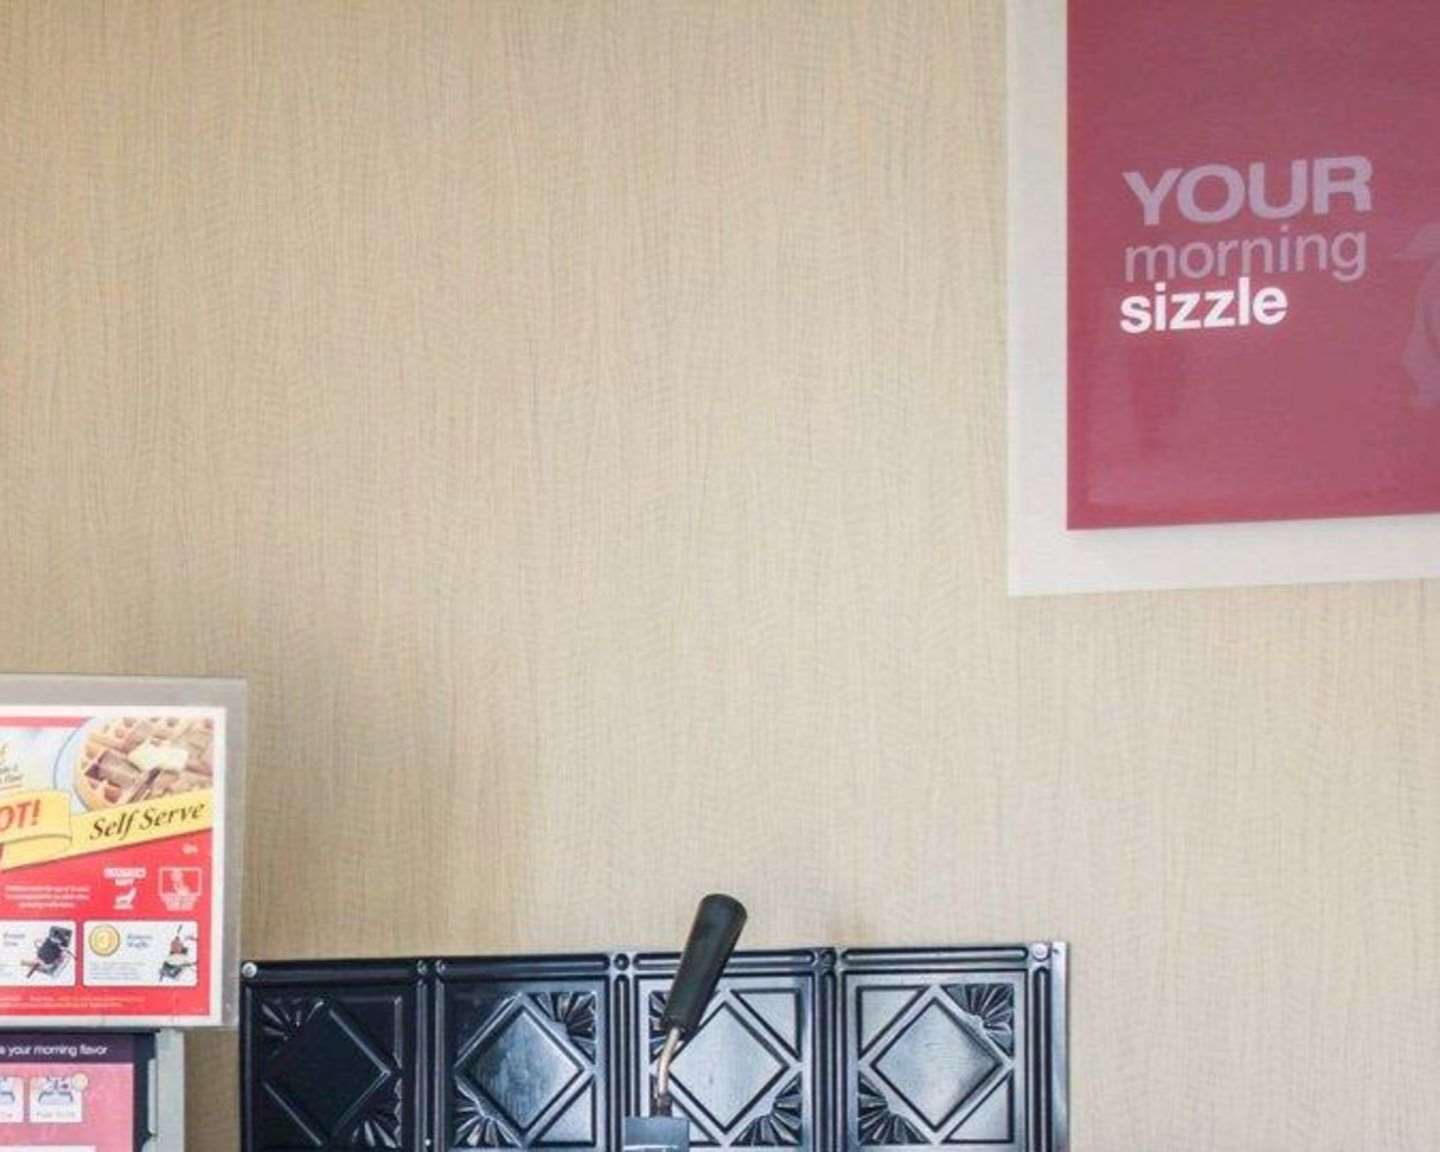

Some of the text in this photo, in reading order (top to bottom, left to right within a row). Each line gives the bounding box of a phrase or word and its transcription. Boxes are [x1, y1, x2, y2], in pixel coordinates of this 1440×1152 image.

[1122, 156, 1373, 226] YOUR
[1125, 224, 1367, 282] morning
[1120, 277, 1288, 334] sizzle
[89, 803, 206, 841] Self Serve
[8, 1045, 31, 1057] your
[34, 1044, 77, 1057] morning
[79, 1043, 108, 1055] flavor
